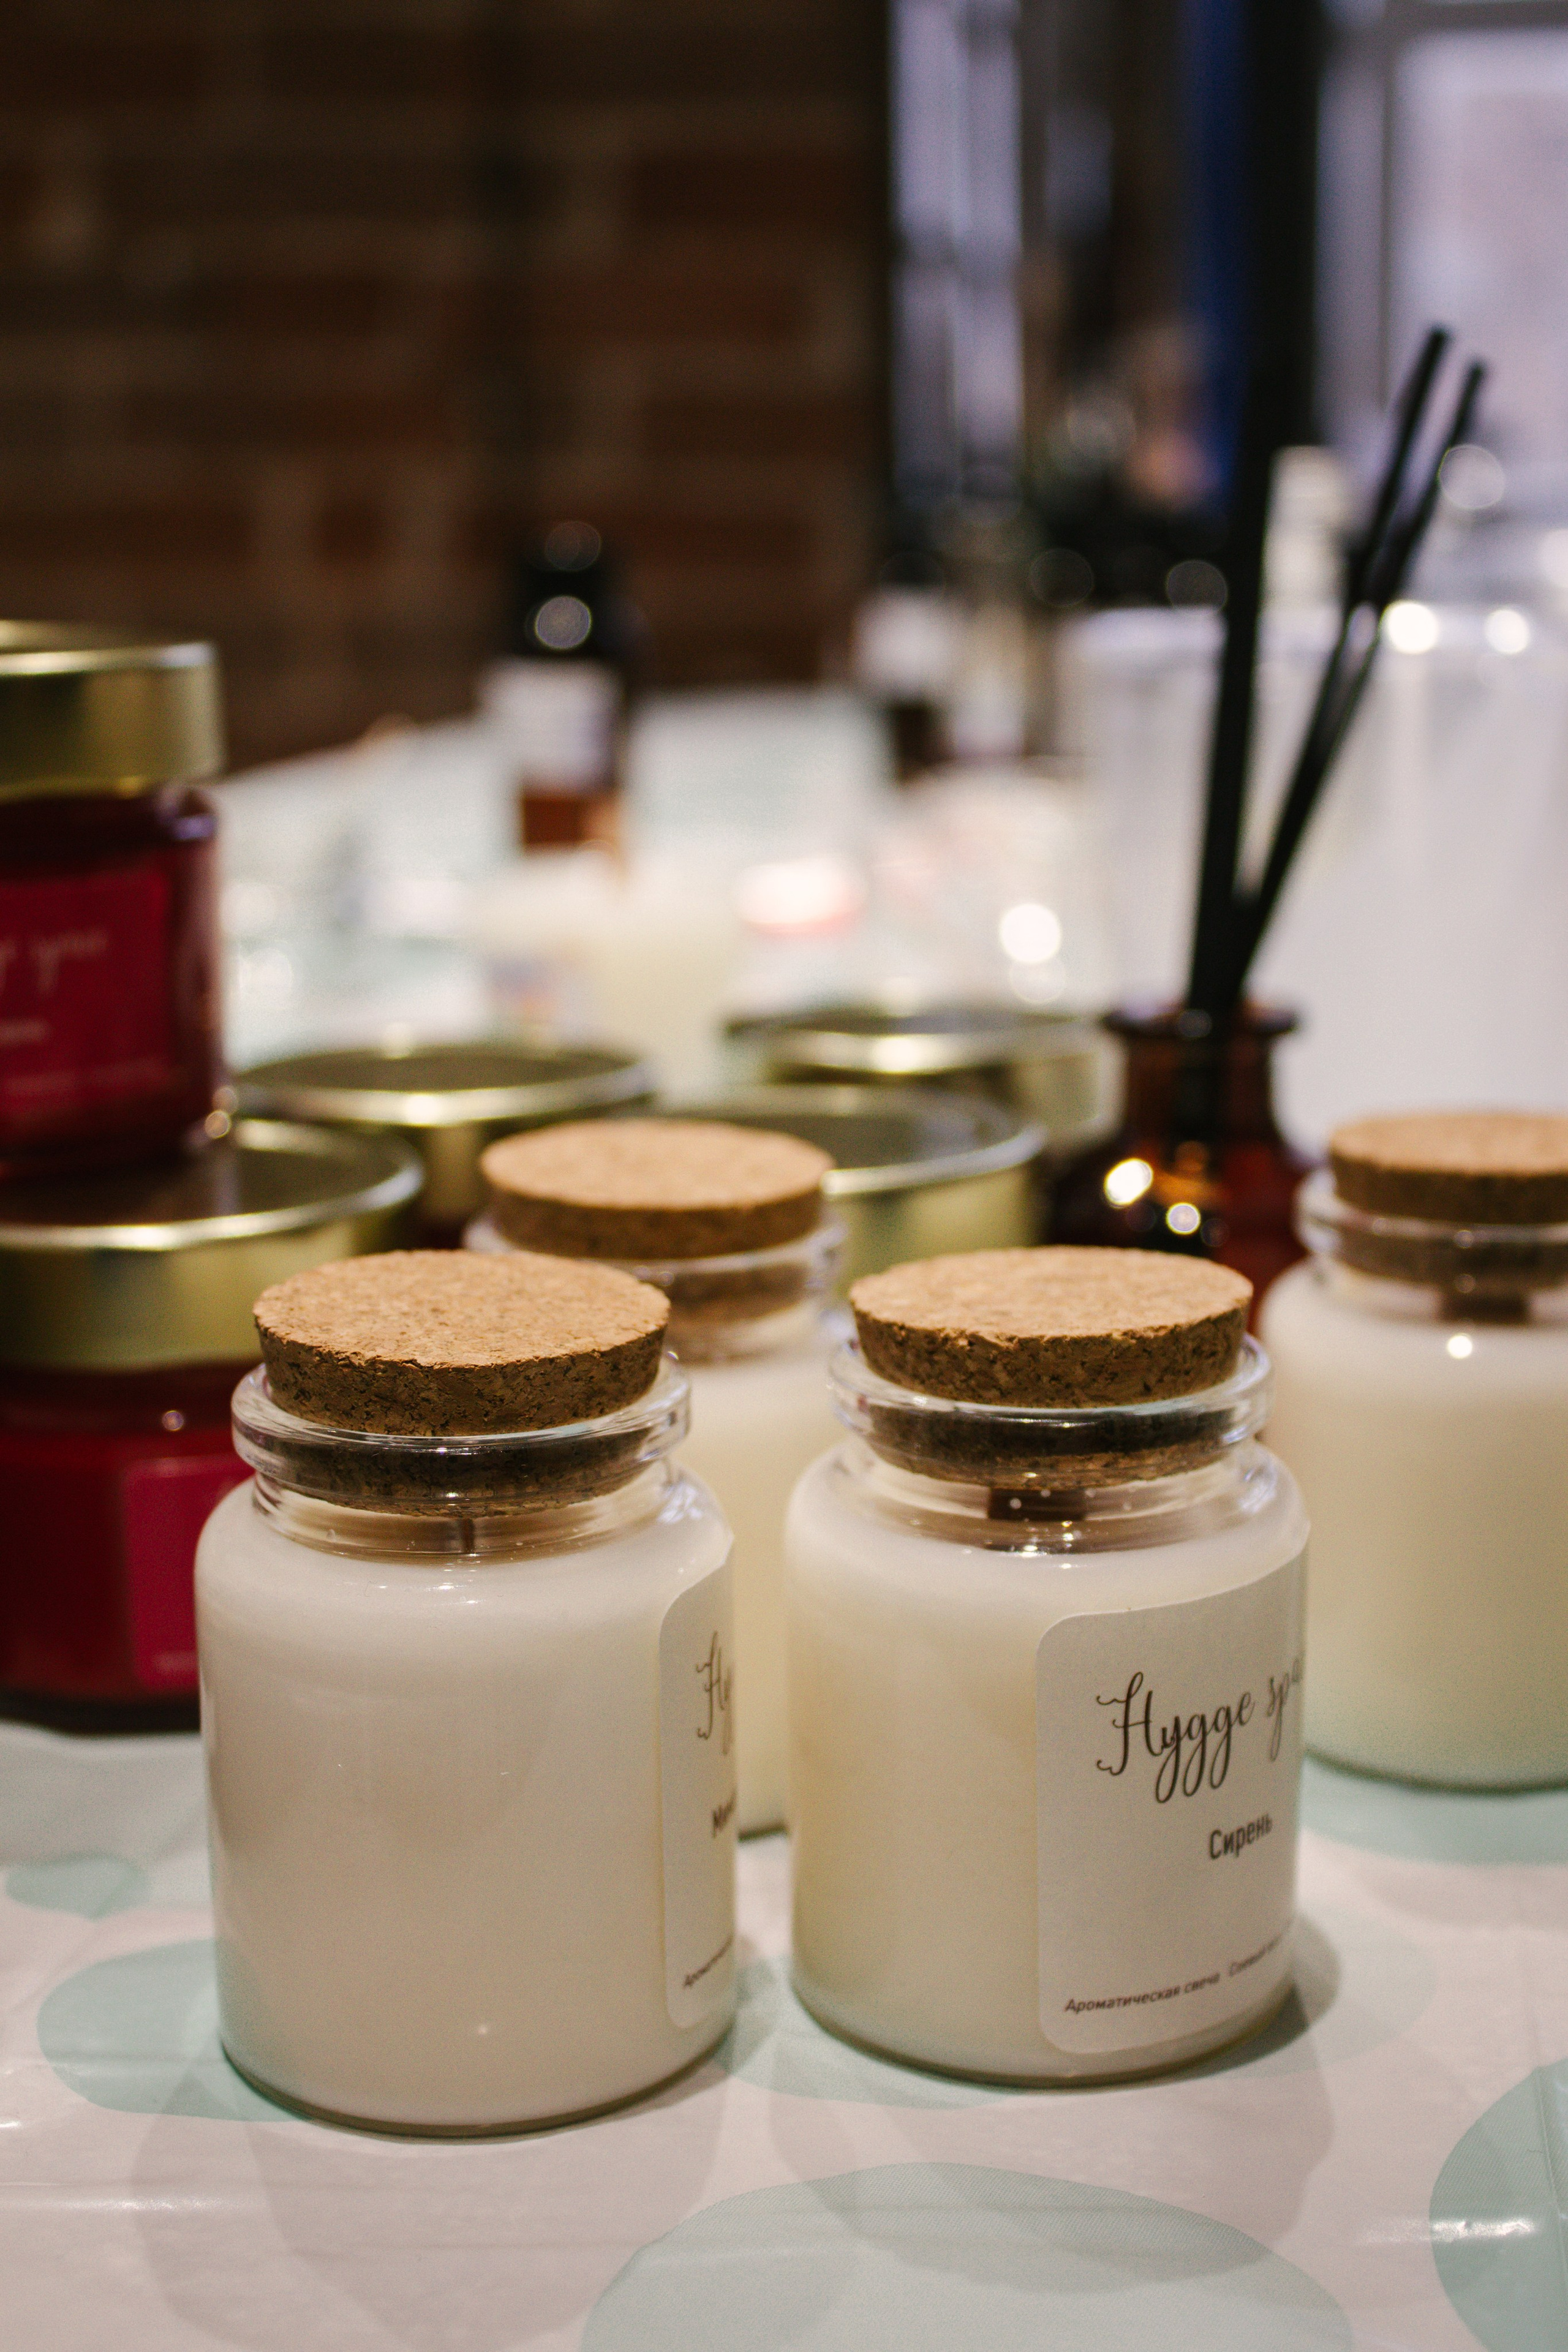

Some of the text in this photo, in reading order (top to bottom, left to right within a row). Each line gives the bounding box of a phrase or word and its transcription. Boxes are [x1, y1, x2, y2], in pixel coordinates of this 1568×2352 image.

[1096, 1672, 1256, 1803] Hygge
[1209, 1814, 1272, 1859] Сирень
[1065, 1972, 1220, 2013] Ароматическая свеча
